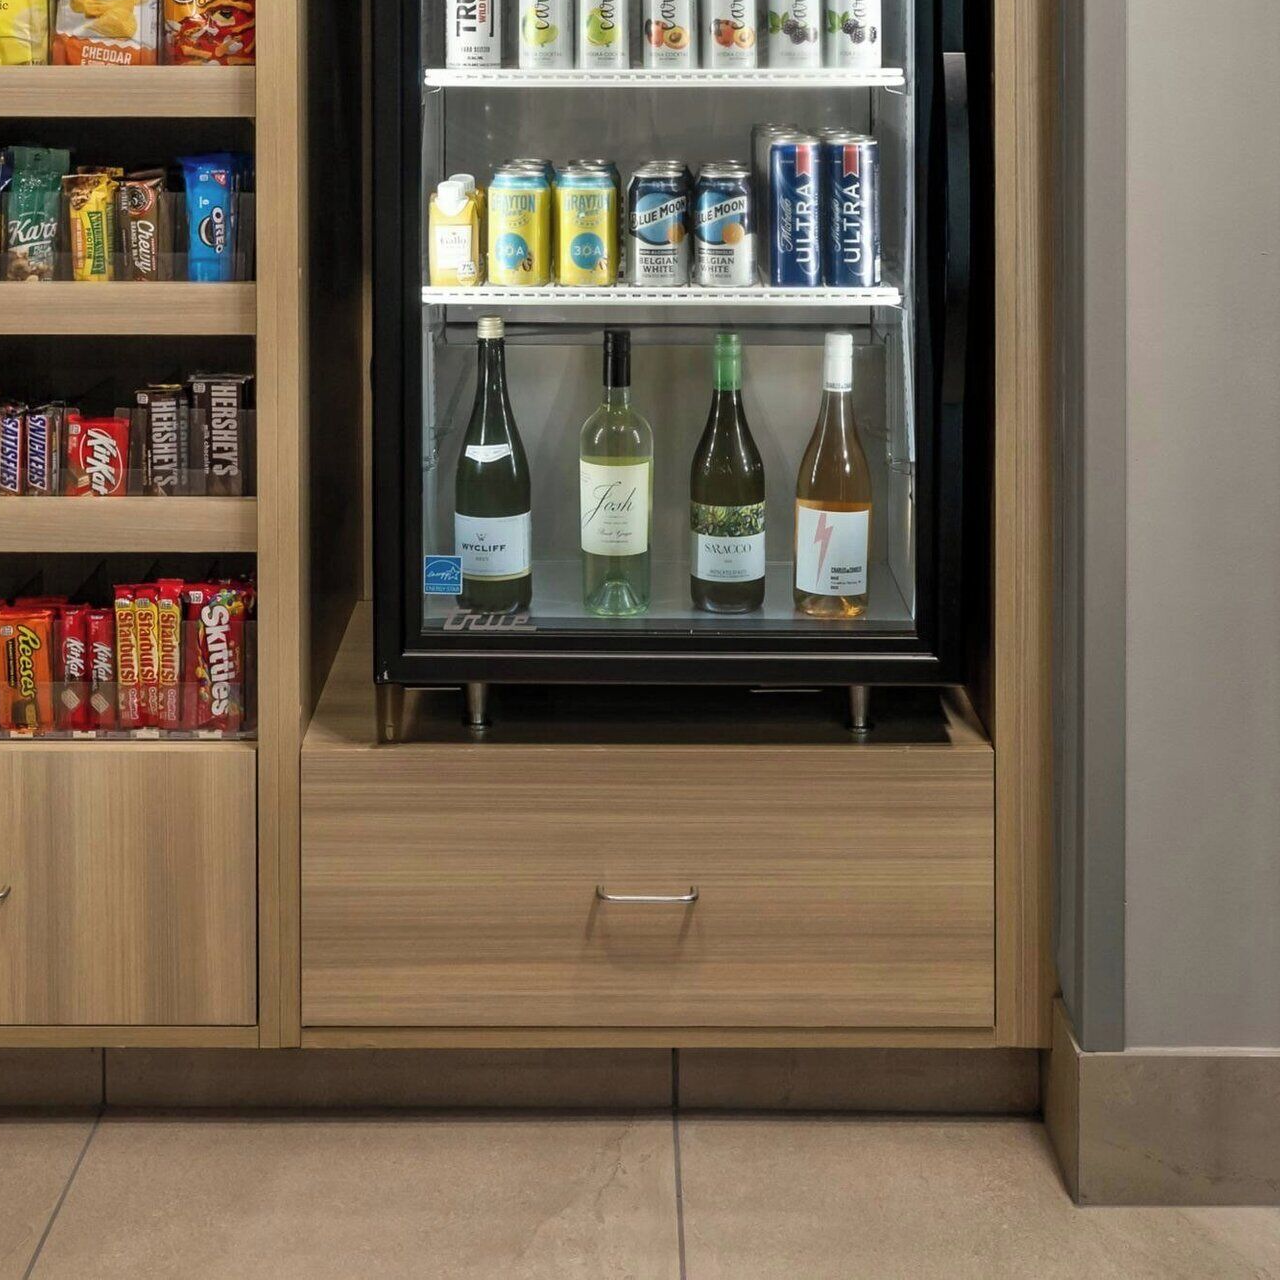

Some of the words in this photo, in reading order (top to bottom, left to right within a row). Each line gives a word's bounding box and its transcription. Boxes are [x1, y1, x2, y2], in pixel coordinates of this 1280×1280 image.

[479, 4, 487, 24] WILD
[81, 45, 132, 64] CHEDDAR
[211, 206, 224, 254] OREO
[631, 211, 658, 229] BLUE
[659, 199, 687, 216] MOON
[714, 200, 745, 217] MOON
[796, 182, 813, 263] ULTRA
[844, 182, 860, 264] ULTRA
[135, 220, 155, 273] Chewy
[639, 257, 678, 265] BELGIAN
[701, 266, 730, 274] WHITE
[27, 414, 47, 490] SNICKERS
[151, 400, 178, 488] HERSHEY'S
[210, 385, 238, 477] HERSHEY'S
[583, 480, 636, 530] Josh
[461, 543, 506, 552] WYCLIFF
[704, 543, 753, 555] SARACCO
[18, 624, 41, 699] Reese's
[119, 611, 138, 686] Starburst
[138, 610, 158, 684] Starburst
[159, 611, 178, 686] Starburst
[201, 605, 236, 717] Skittles
